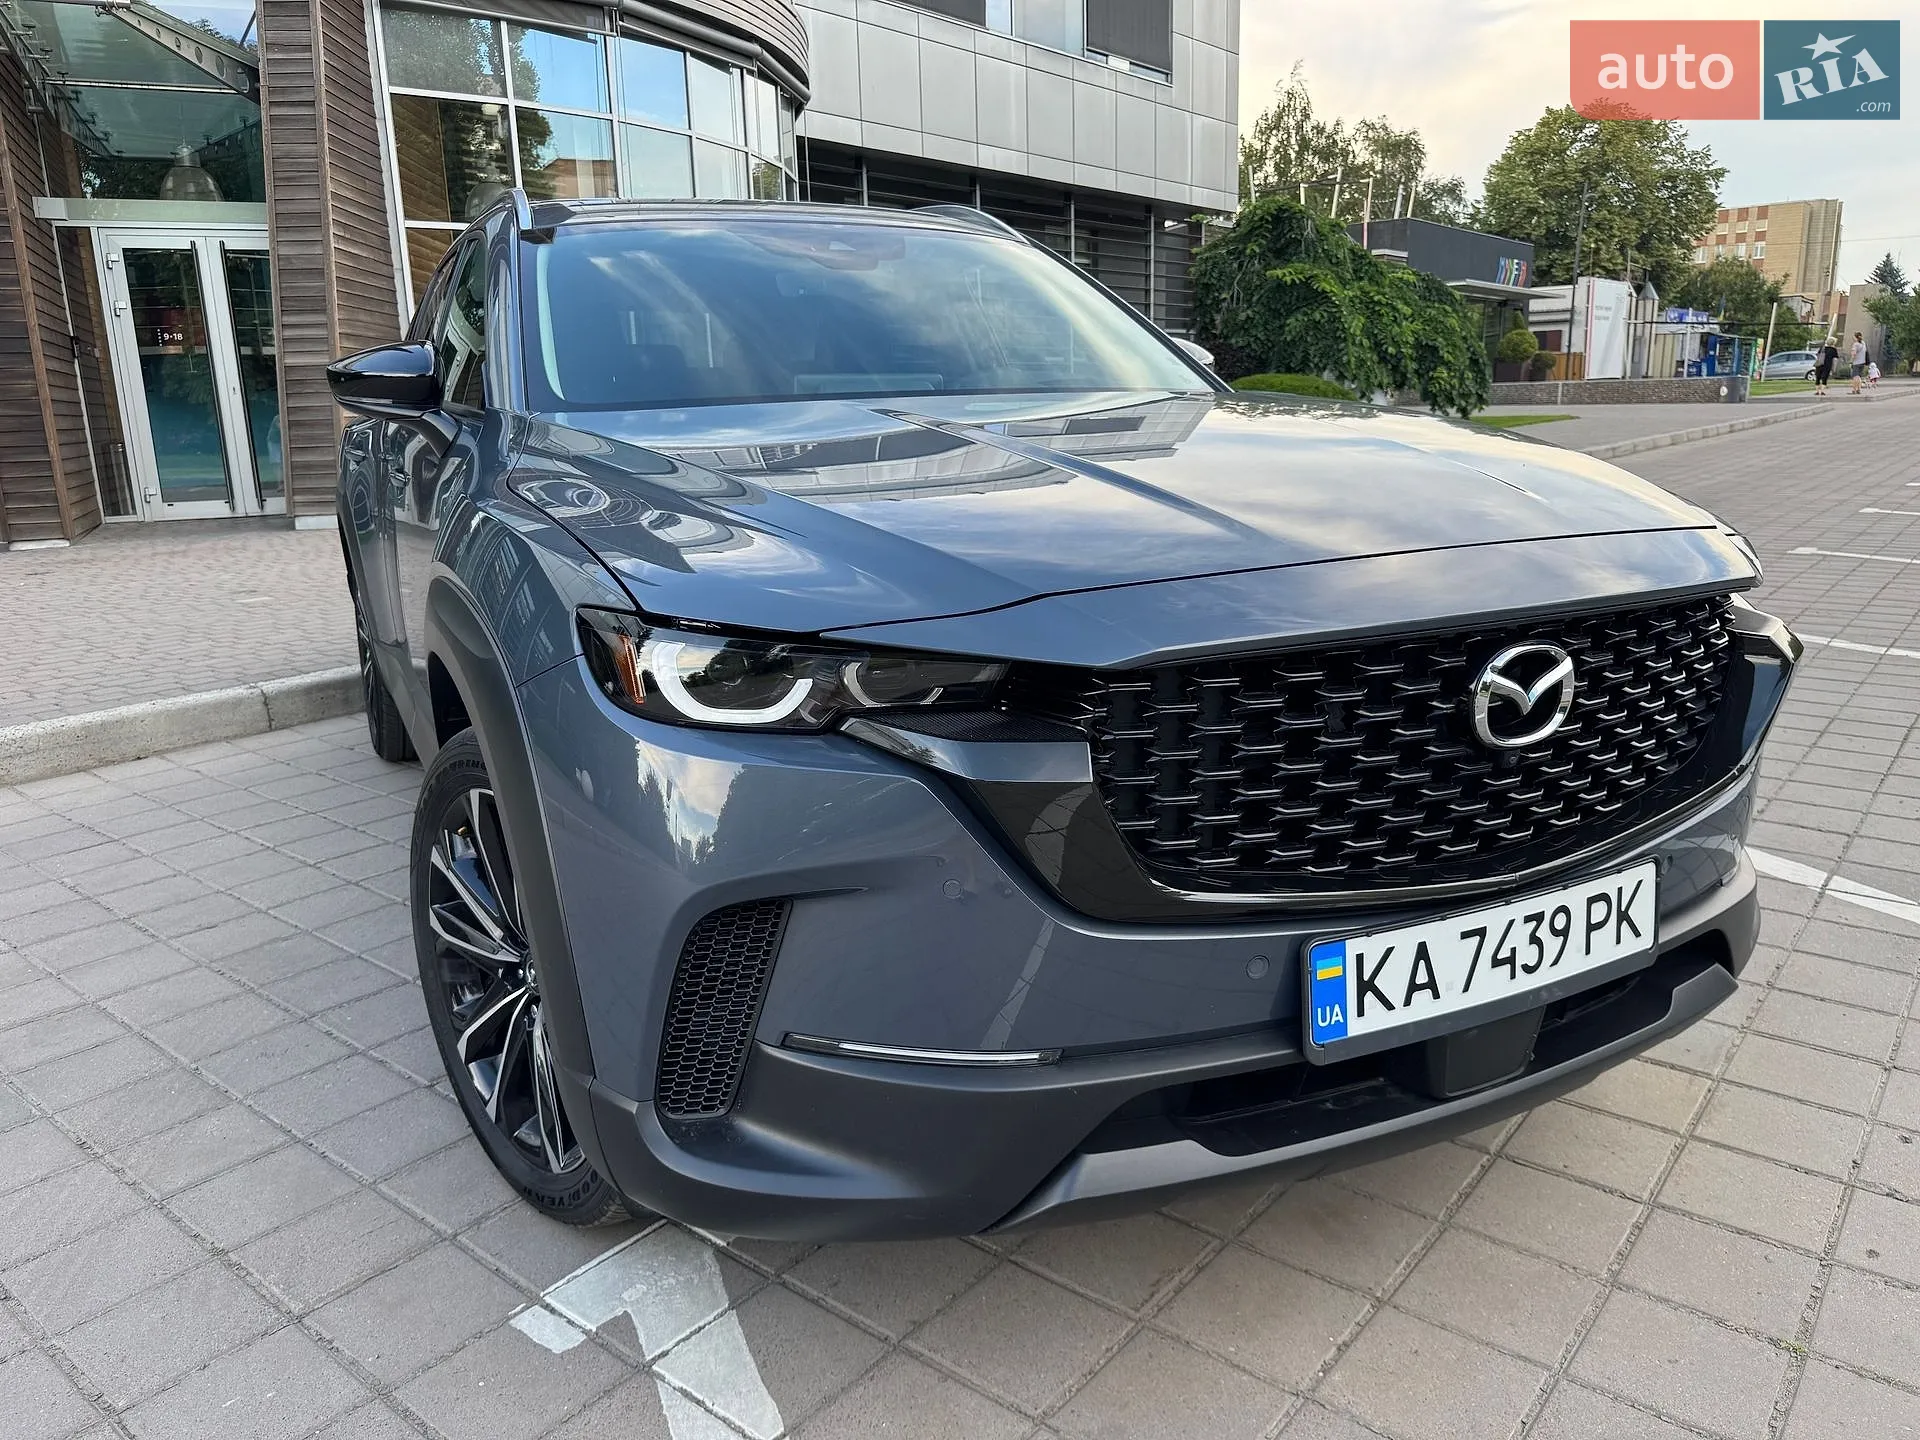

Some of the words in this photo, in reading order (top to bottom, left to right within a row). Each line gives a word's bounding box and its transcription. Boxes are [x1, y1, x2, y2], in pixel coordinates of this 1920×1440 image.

[1355, 940, 1441, 1018] KA
[1459, 904, 1572, 993] 7439
[1584, 879, 1644, 956] PK
[1317, 1003, 1344, 1027] UA
